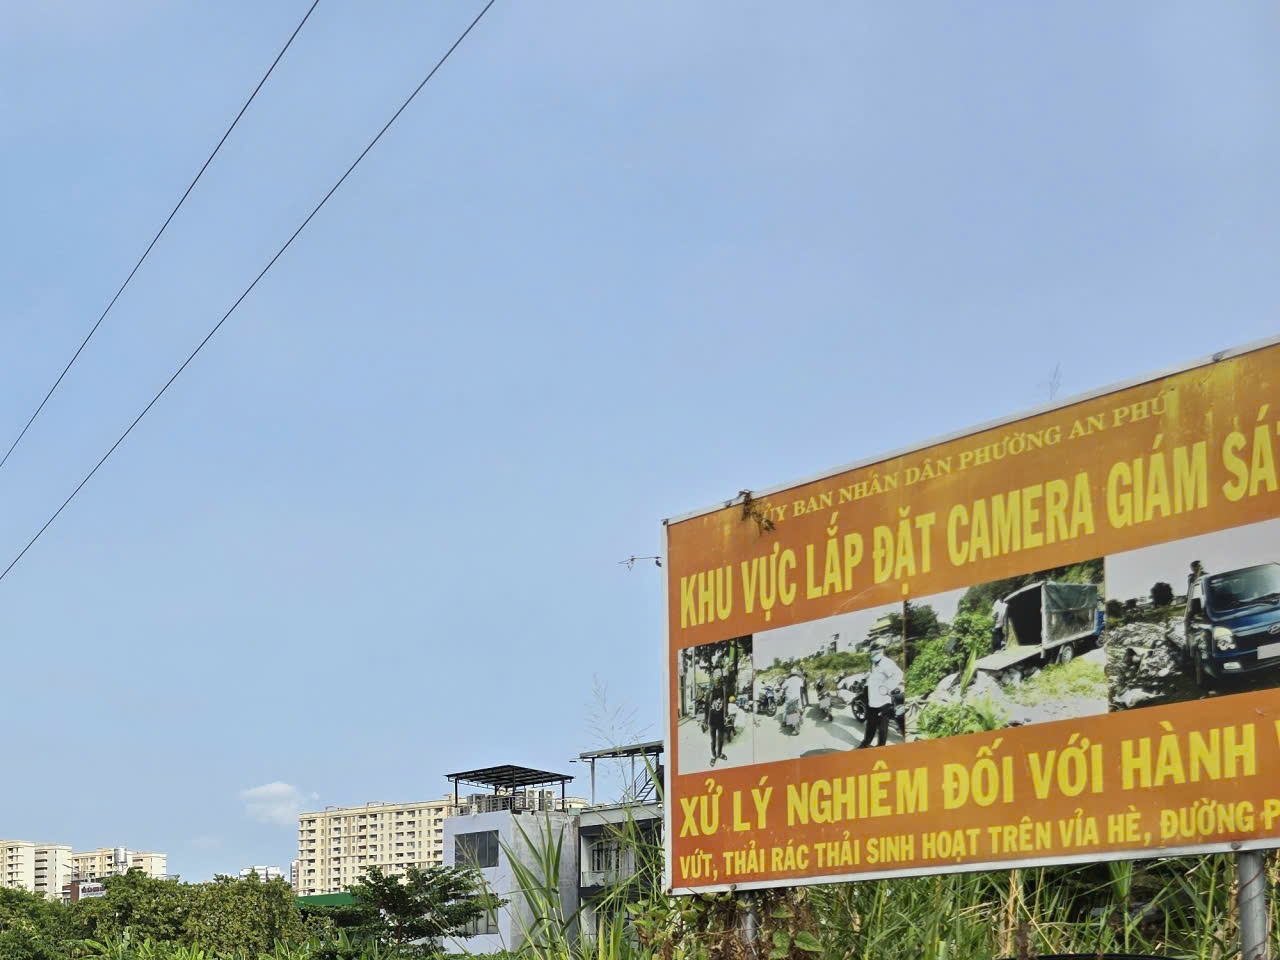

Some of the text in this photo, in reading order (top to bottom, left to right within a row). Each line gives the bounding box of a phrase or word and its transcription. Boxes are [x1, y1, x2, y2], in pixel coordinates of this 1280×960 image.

[680, 403, 1280, 630] KHU VỰC LẮP ĐẶT CAMERA GIÁM SÁ
[792, 491, 833, 518] BAN
[838, 472, 899, 504] NHÂN
[905, 456, 952, 484] DÂN
[959, 425, 1062, 471] PHƯỜNG
[1069, 413, 1106, 440] AN
[679, 778, 723, 838] XỬ
[732, 776, 773, 832] LÝ
[786, 759, 929, 827] NGHIÊM
[942, 737, 1015, 810] ĐỐI
[1028, 732, 1104, 800] VỚI
[1121, 720, 1257, 790] HÀNH
[679, 848, 718, 881] VỨT,
[723, 839, 765, 876] THẢI
[771, 838, 809, 872] RÁC
[814, 830, 861, 868] THẢI
[866, 834, 915, 865] SINH
[922, 828, 981, 863] HOẠT
[988, 815, 1052, 855] TRÊN
[1059, 807, 1100, 848] VỈA
[1107, 804, 1152, 847] HÈ,
[1160, 797, 1255, 840] ĐƯỜNG
